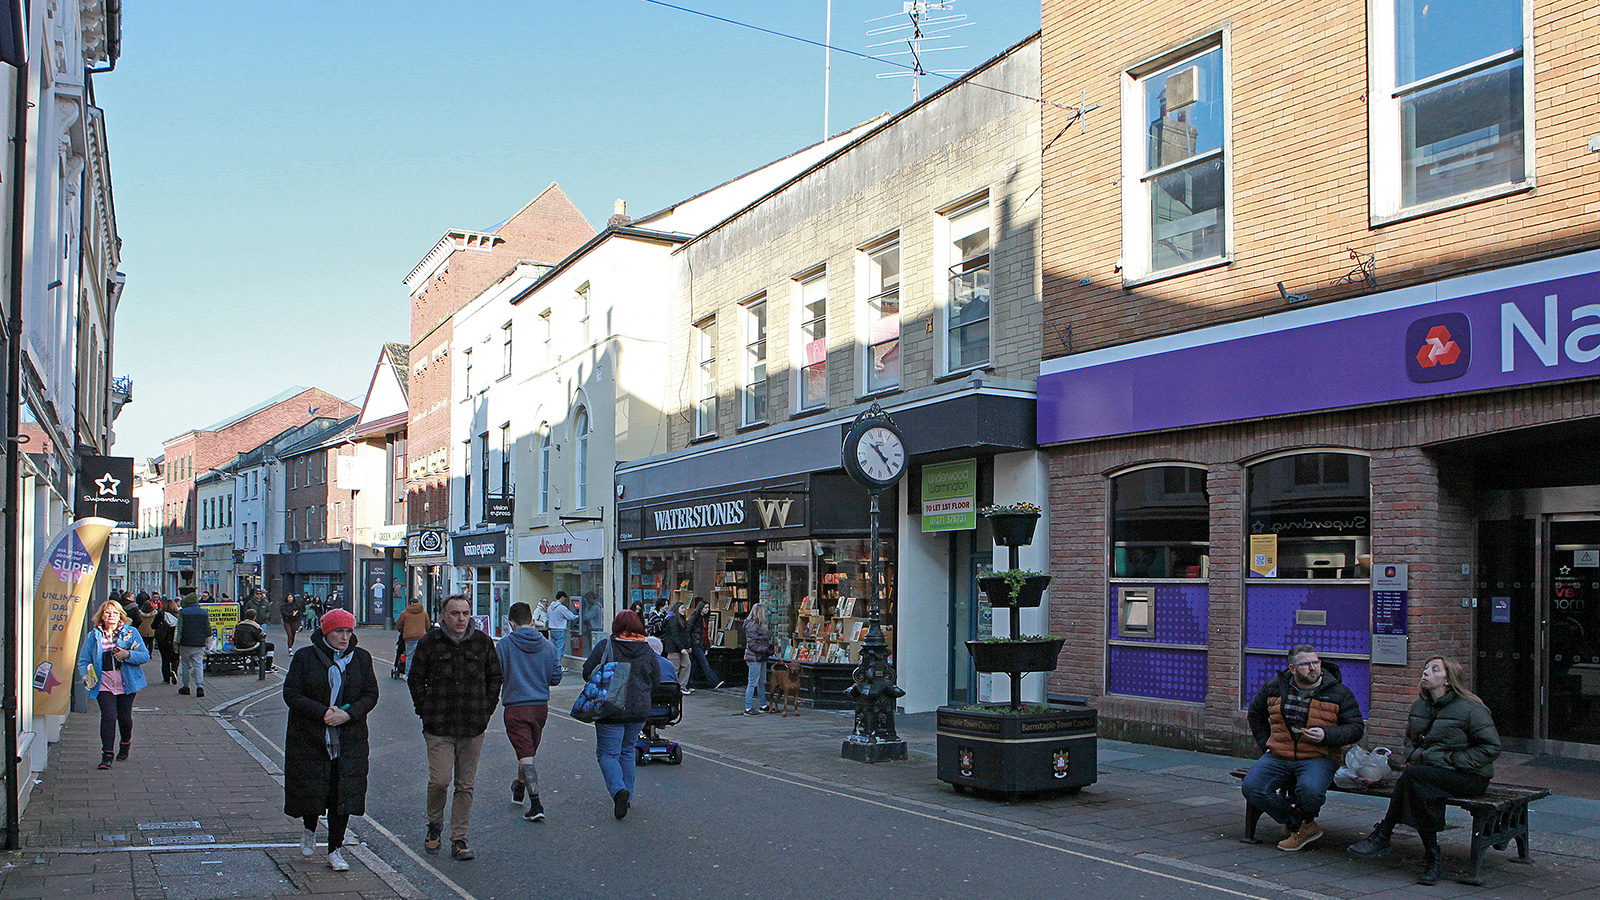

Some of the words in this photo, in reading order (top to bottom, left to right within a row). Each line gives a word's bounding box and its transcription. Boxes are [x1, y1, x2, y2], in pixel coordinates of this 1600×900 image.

[928, 471, 968, 483] Underwood
[928, 482, 968, 493] Warmington
[83, 495, 131, 504] Superdrug
[932, 504, 941, 512] LET
[942, 503, 951, 511] 1ST
[951, 501, 970, 510] FLOOR
[653, 500, 745, 531] WATERSTONES
[930, 516, 945, 524] 01271
[947, 515, 966, 523] 378731
[546, 537, 573, 553] Santander
[53, 559, 95, 576] SUPER
[1021, 721, 1056, 732] Barnstaple
[1056, 720, 1072, 729] Town
